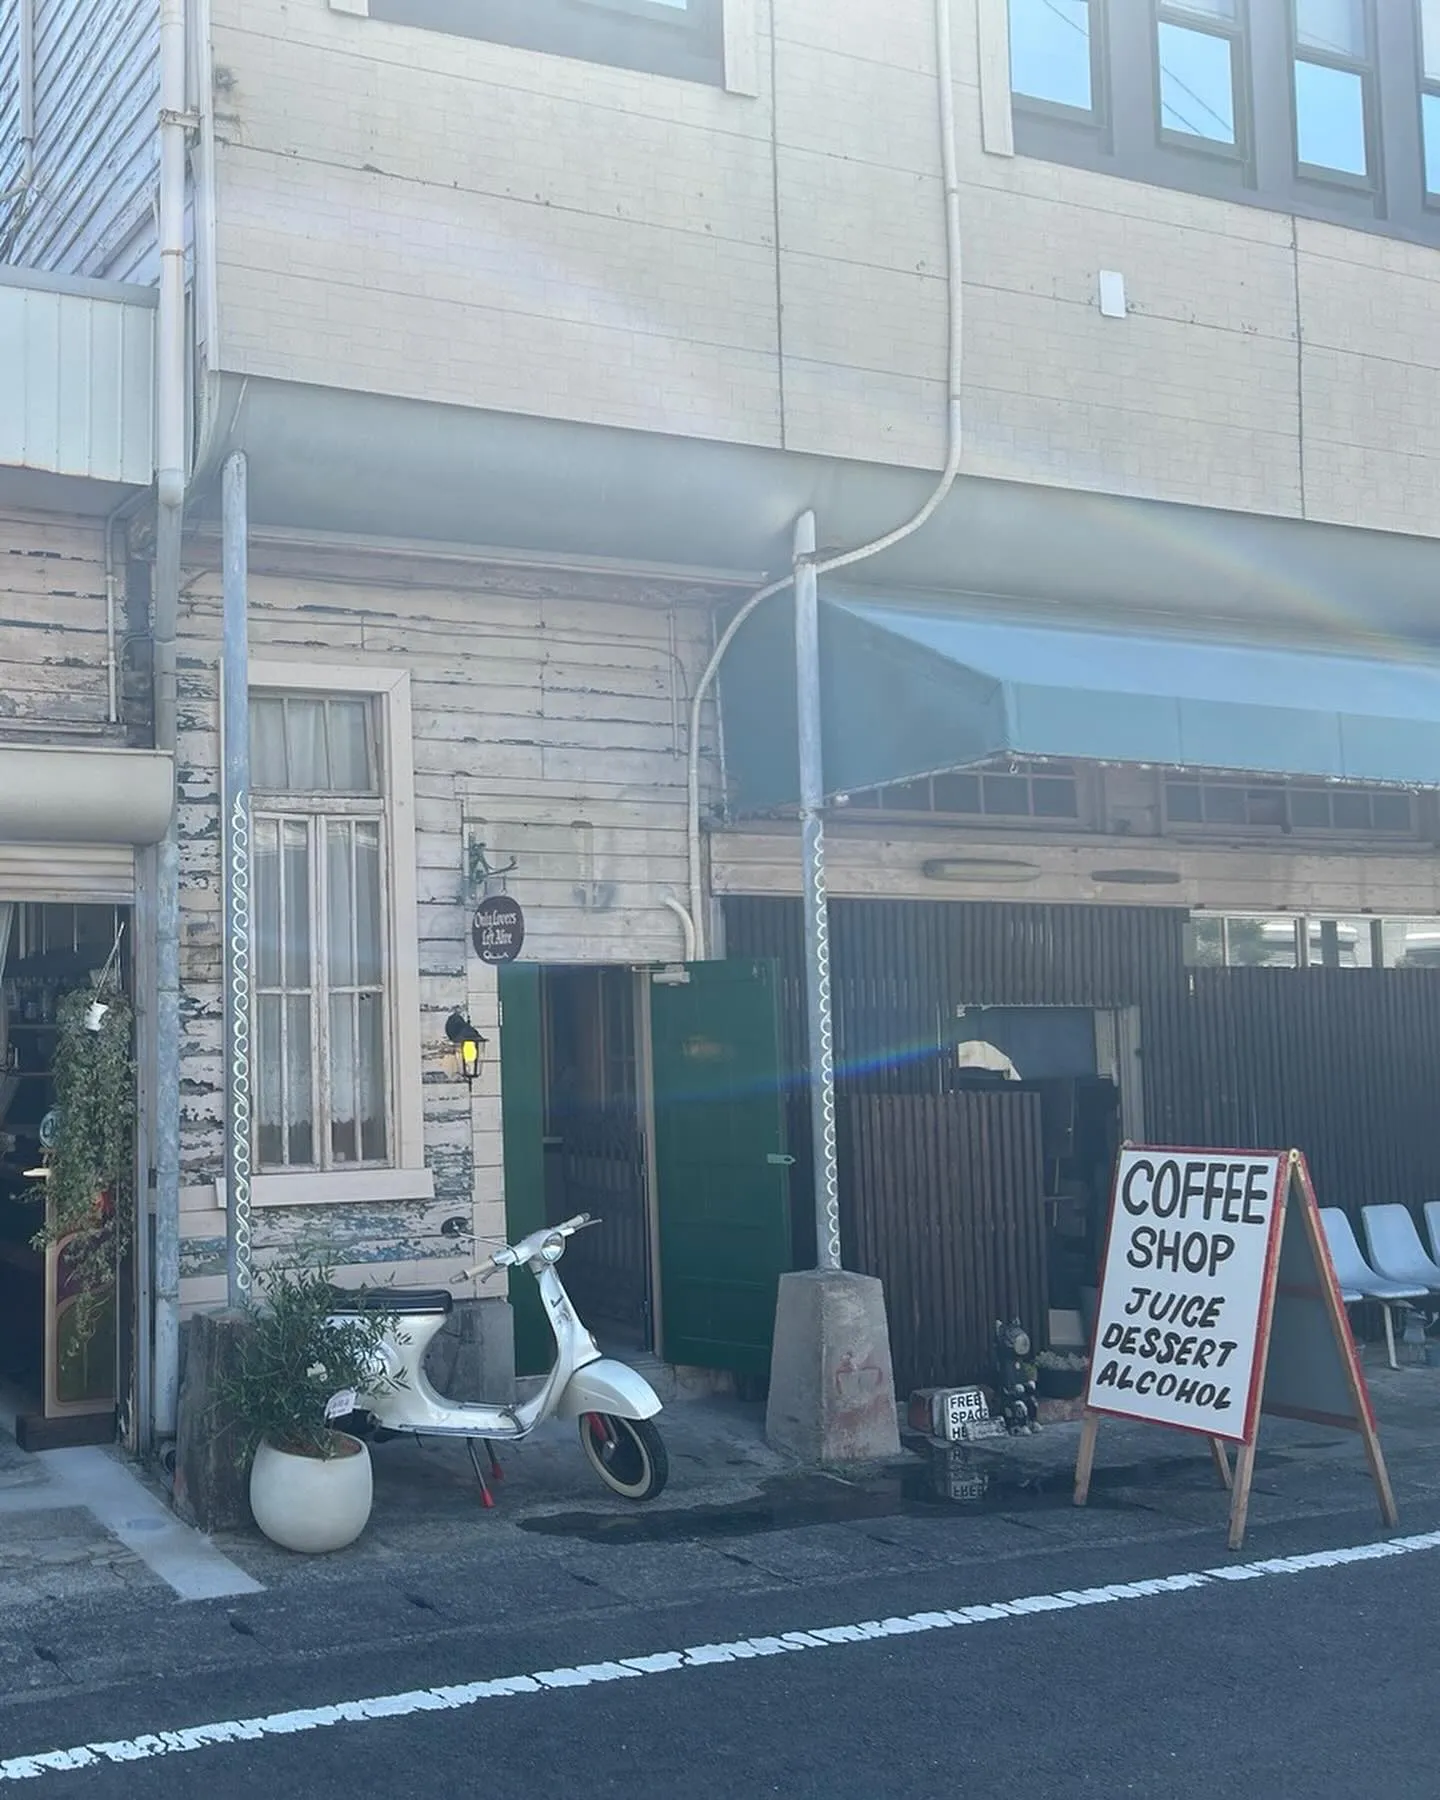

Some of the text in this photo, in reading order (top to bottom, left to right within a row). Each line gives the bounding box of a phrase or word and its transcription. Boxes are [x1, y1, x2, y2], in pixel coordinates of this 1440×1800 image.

[1122, 1159, 1268, 1224] COFFEE
[1126, 1225, 1235, 1277] SHOP
[1124, 1287, 1225, 1328] JUICE
[1101, 1323, 1237, 1369] DESSERT
[950, 1394, 982, 1409] FREE
[1096, 1360, 1231, 1409] ALCOHOL
